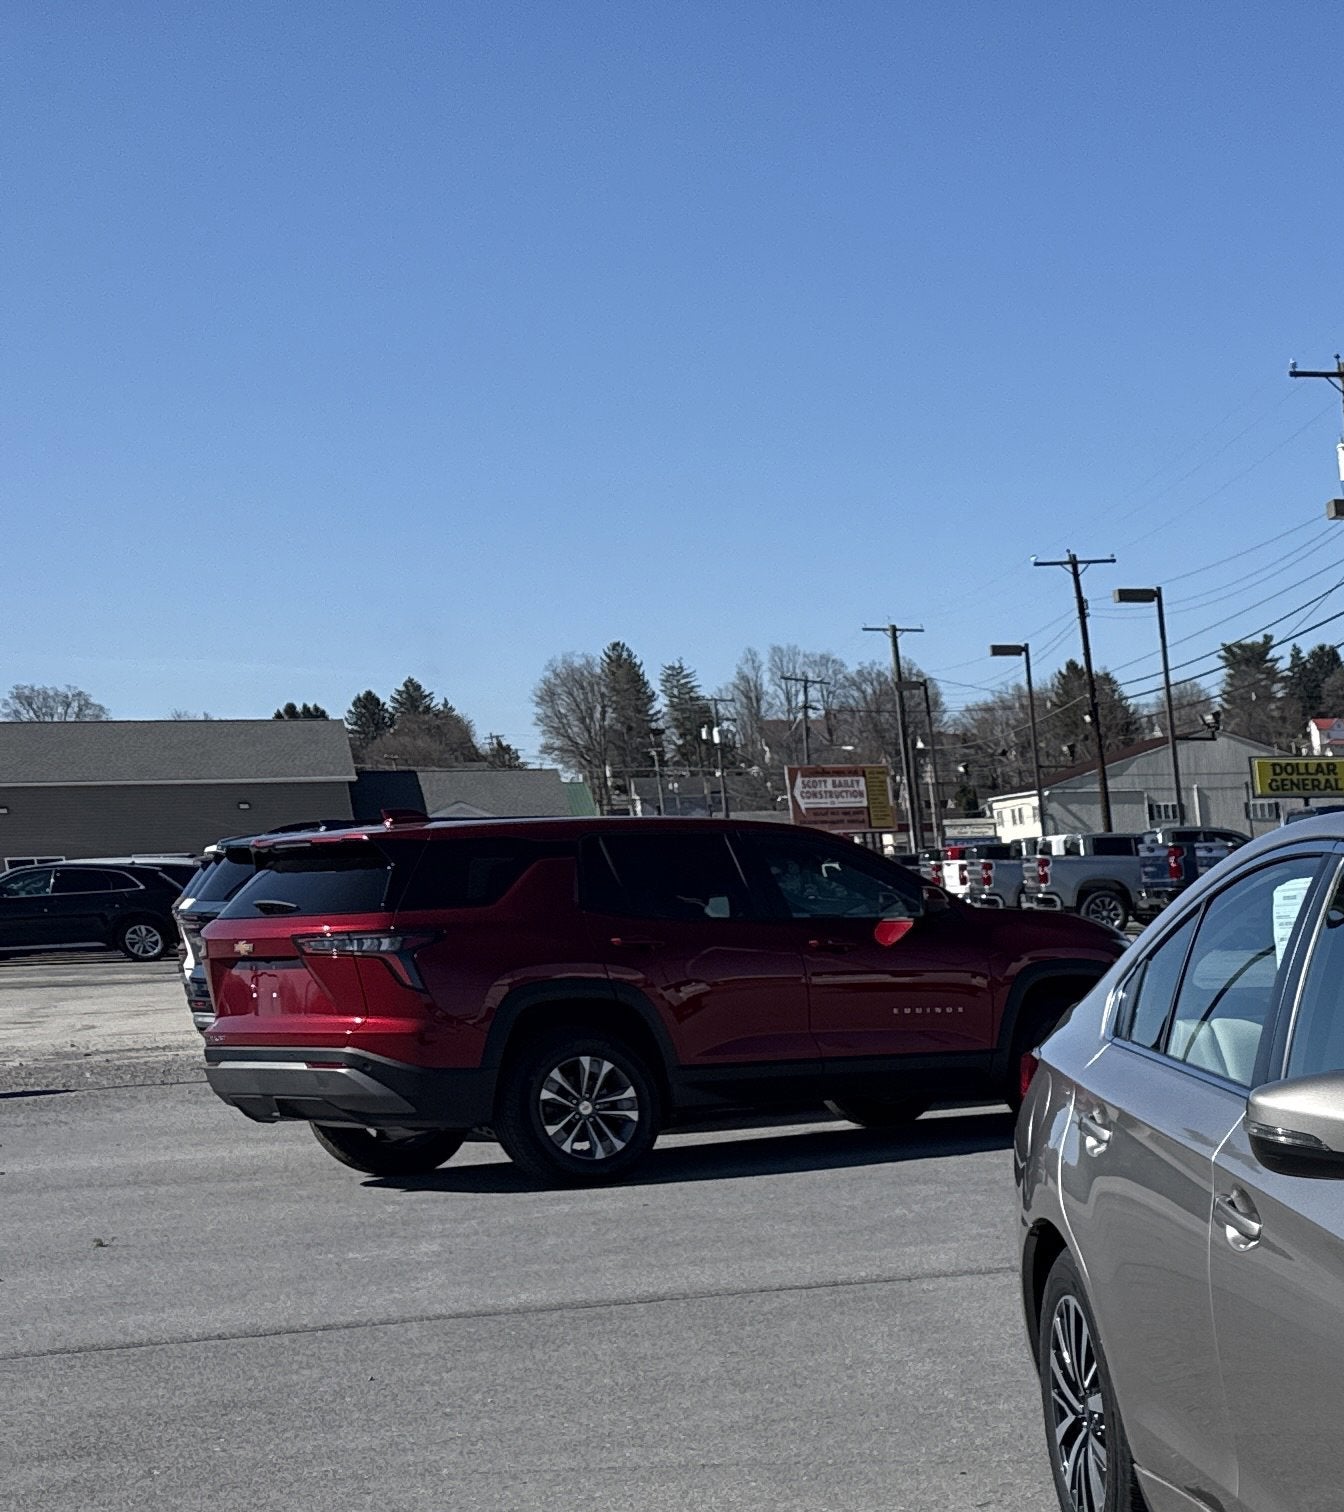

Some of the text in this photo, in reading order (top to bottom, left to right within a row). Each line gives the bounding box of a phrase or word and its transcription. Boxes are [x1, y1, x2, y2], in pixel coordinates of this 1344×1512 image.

[1271, 762, 1338, 776] DOLLAR
[801, 780, 828, 789] SCOTT
[1268, 778, 1344, 792] GENERAL
[800, 789, 865, 799] CONSTRUCTION
